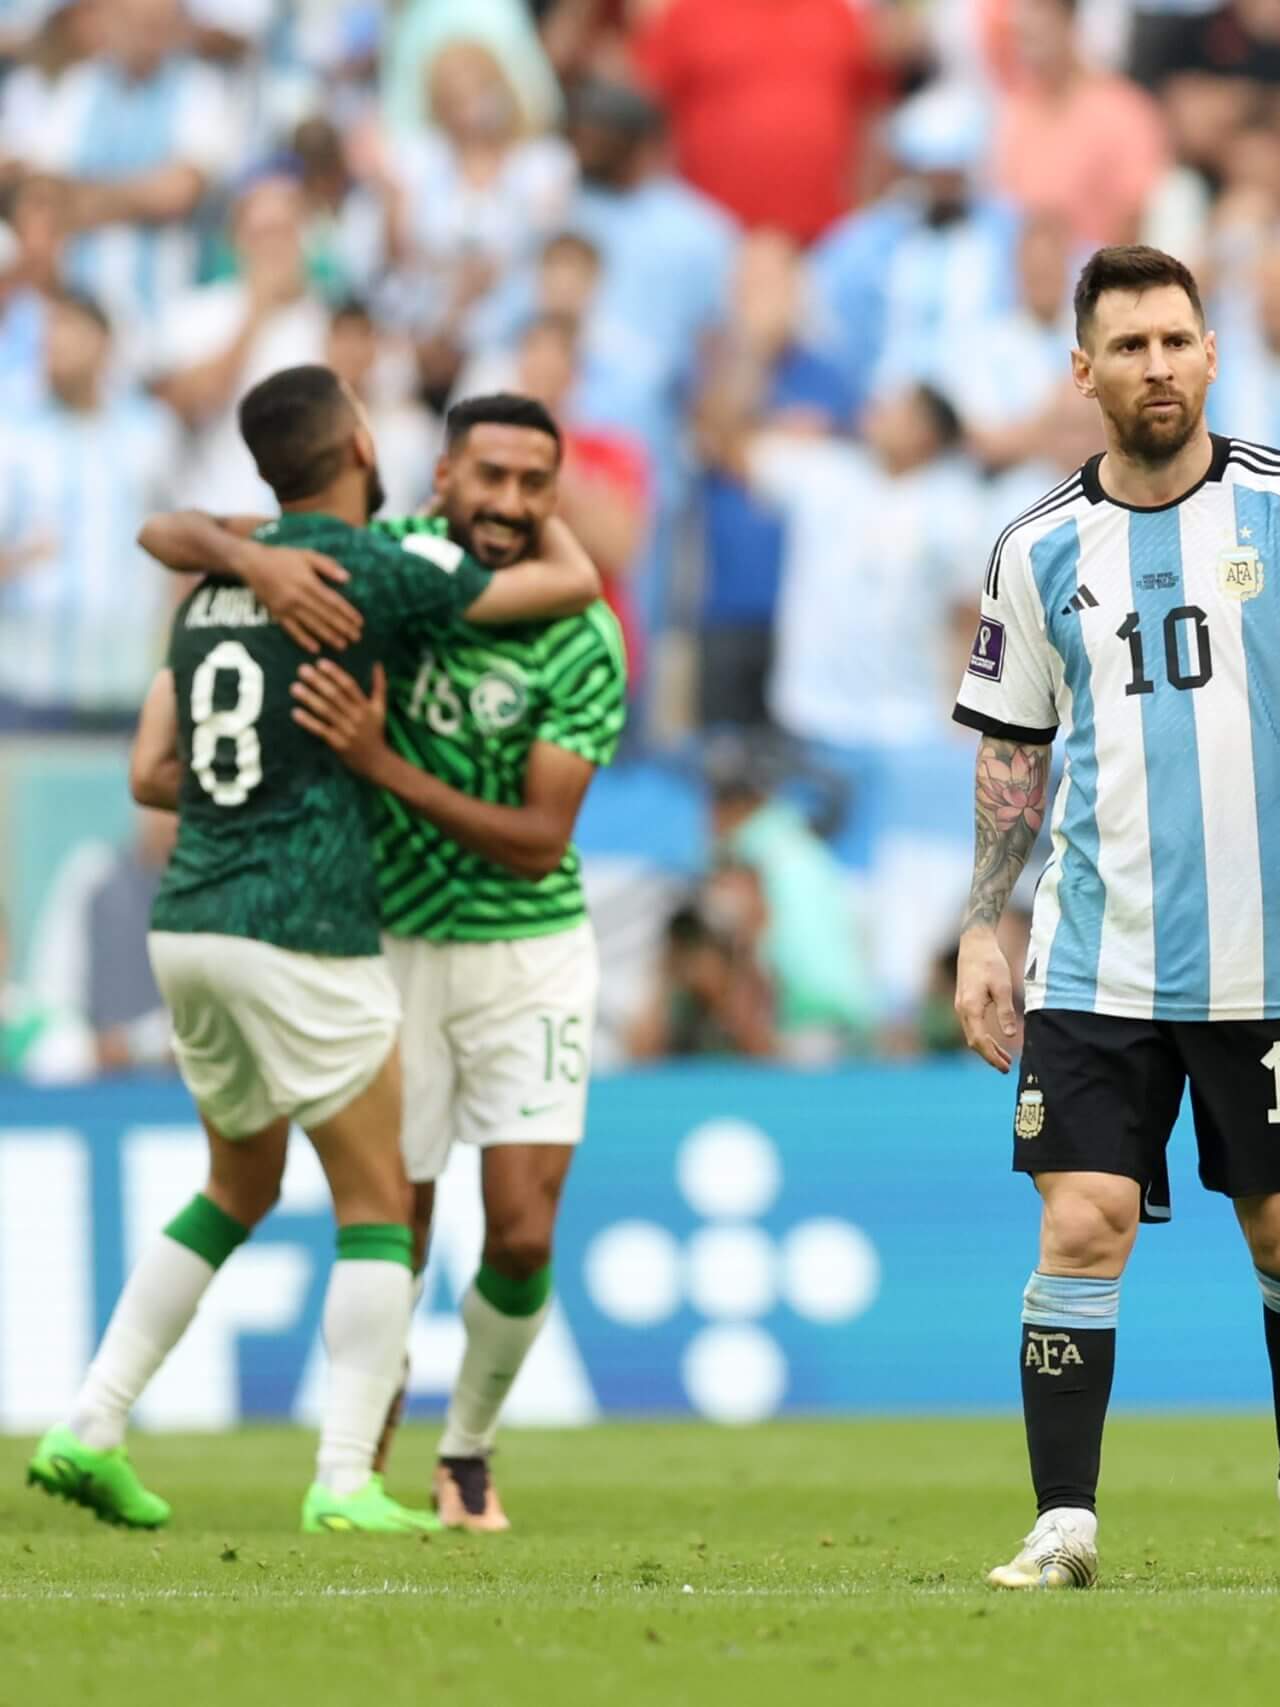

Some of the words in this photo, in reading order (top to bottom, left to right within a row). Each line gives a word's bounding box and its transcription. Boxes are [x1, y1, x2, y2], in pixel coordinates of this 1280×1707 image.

[1226, 561, 1252, 586] AFA
[1116, 604, 1213, 697] 10
[190, 640, 264, 806] 8
[538, 1015, 583, 1082] 15
[1025, 1331, 1084, 1375] AFA
